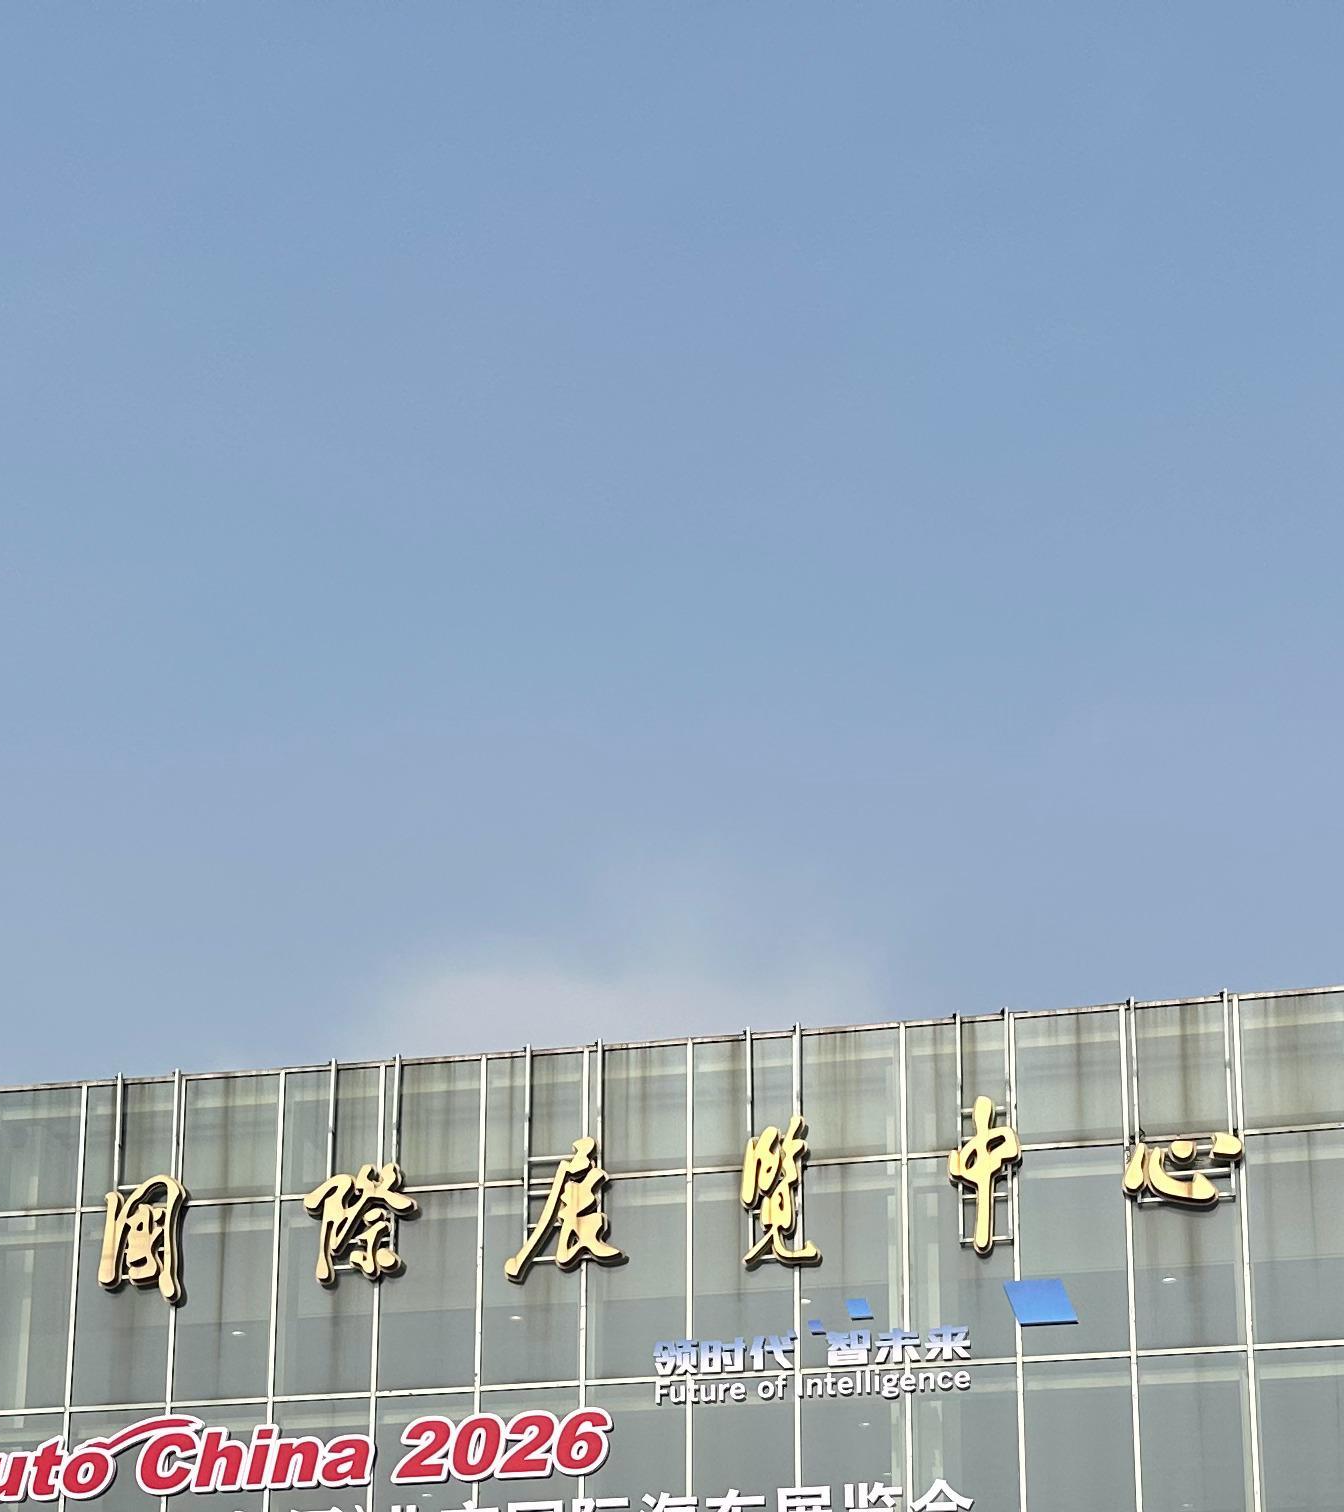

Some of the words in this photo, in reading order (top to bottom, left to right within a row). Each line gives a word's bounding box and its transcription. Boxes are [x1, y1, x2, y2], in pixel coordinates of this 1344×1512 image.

[653, 1329, 798, 1376] 领时代
[826, 1325, 971, 1367] 智未来
[655, 1379, 747, 1405] Future
[757, 1374, 788, 1399] of
[798, 1369, 972, 1399] Intelligence
[137, 1414, 377, 1496] China
[390, 1407, 614, 1485] 2026
